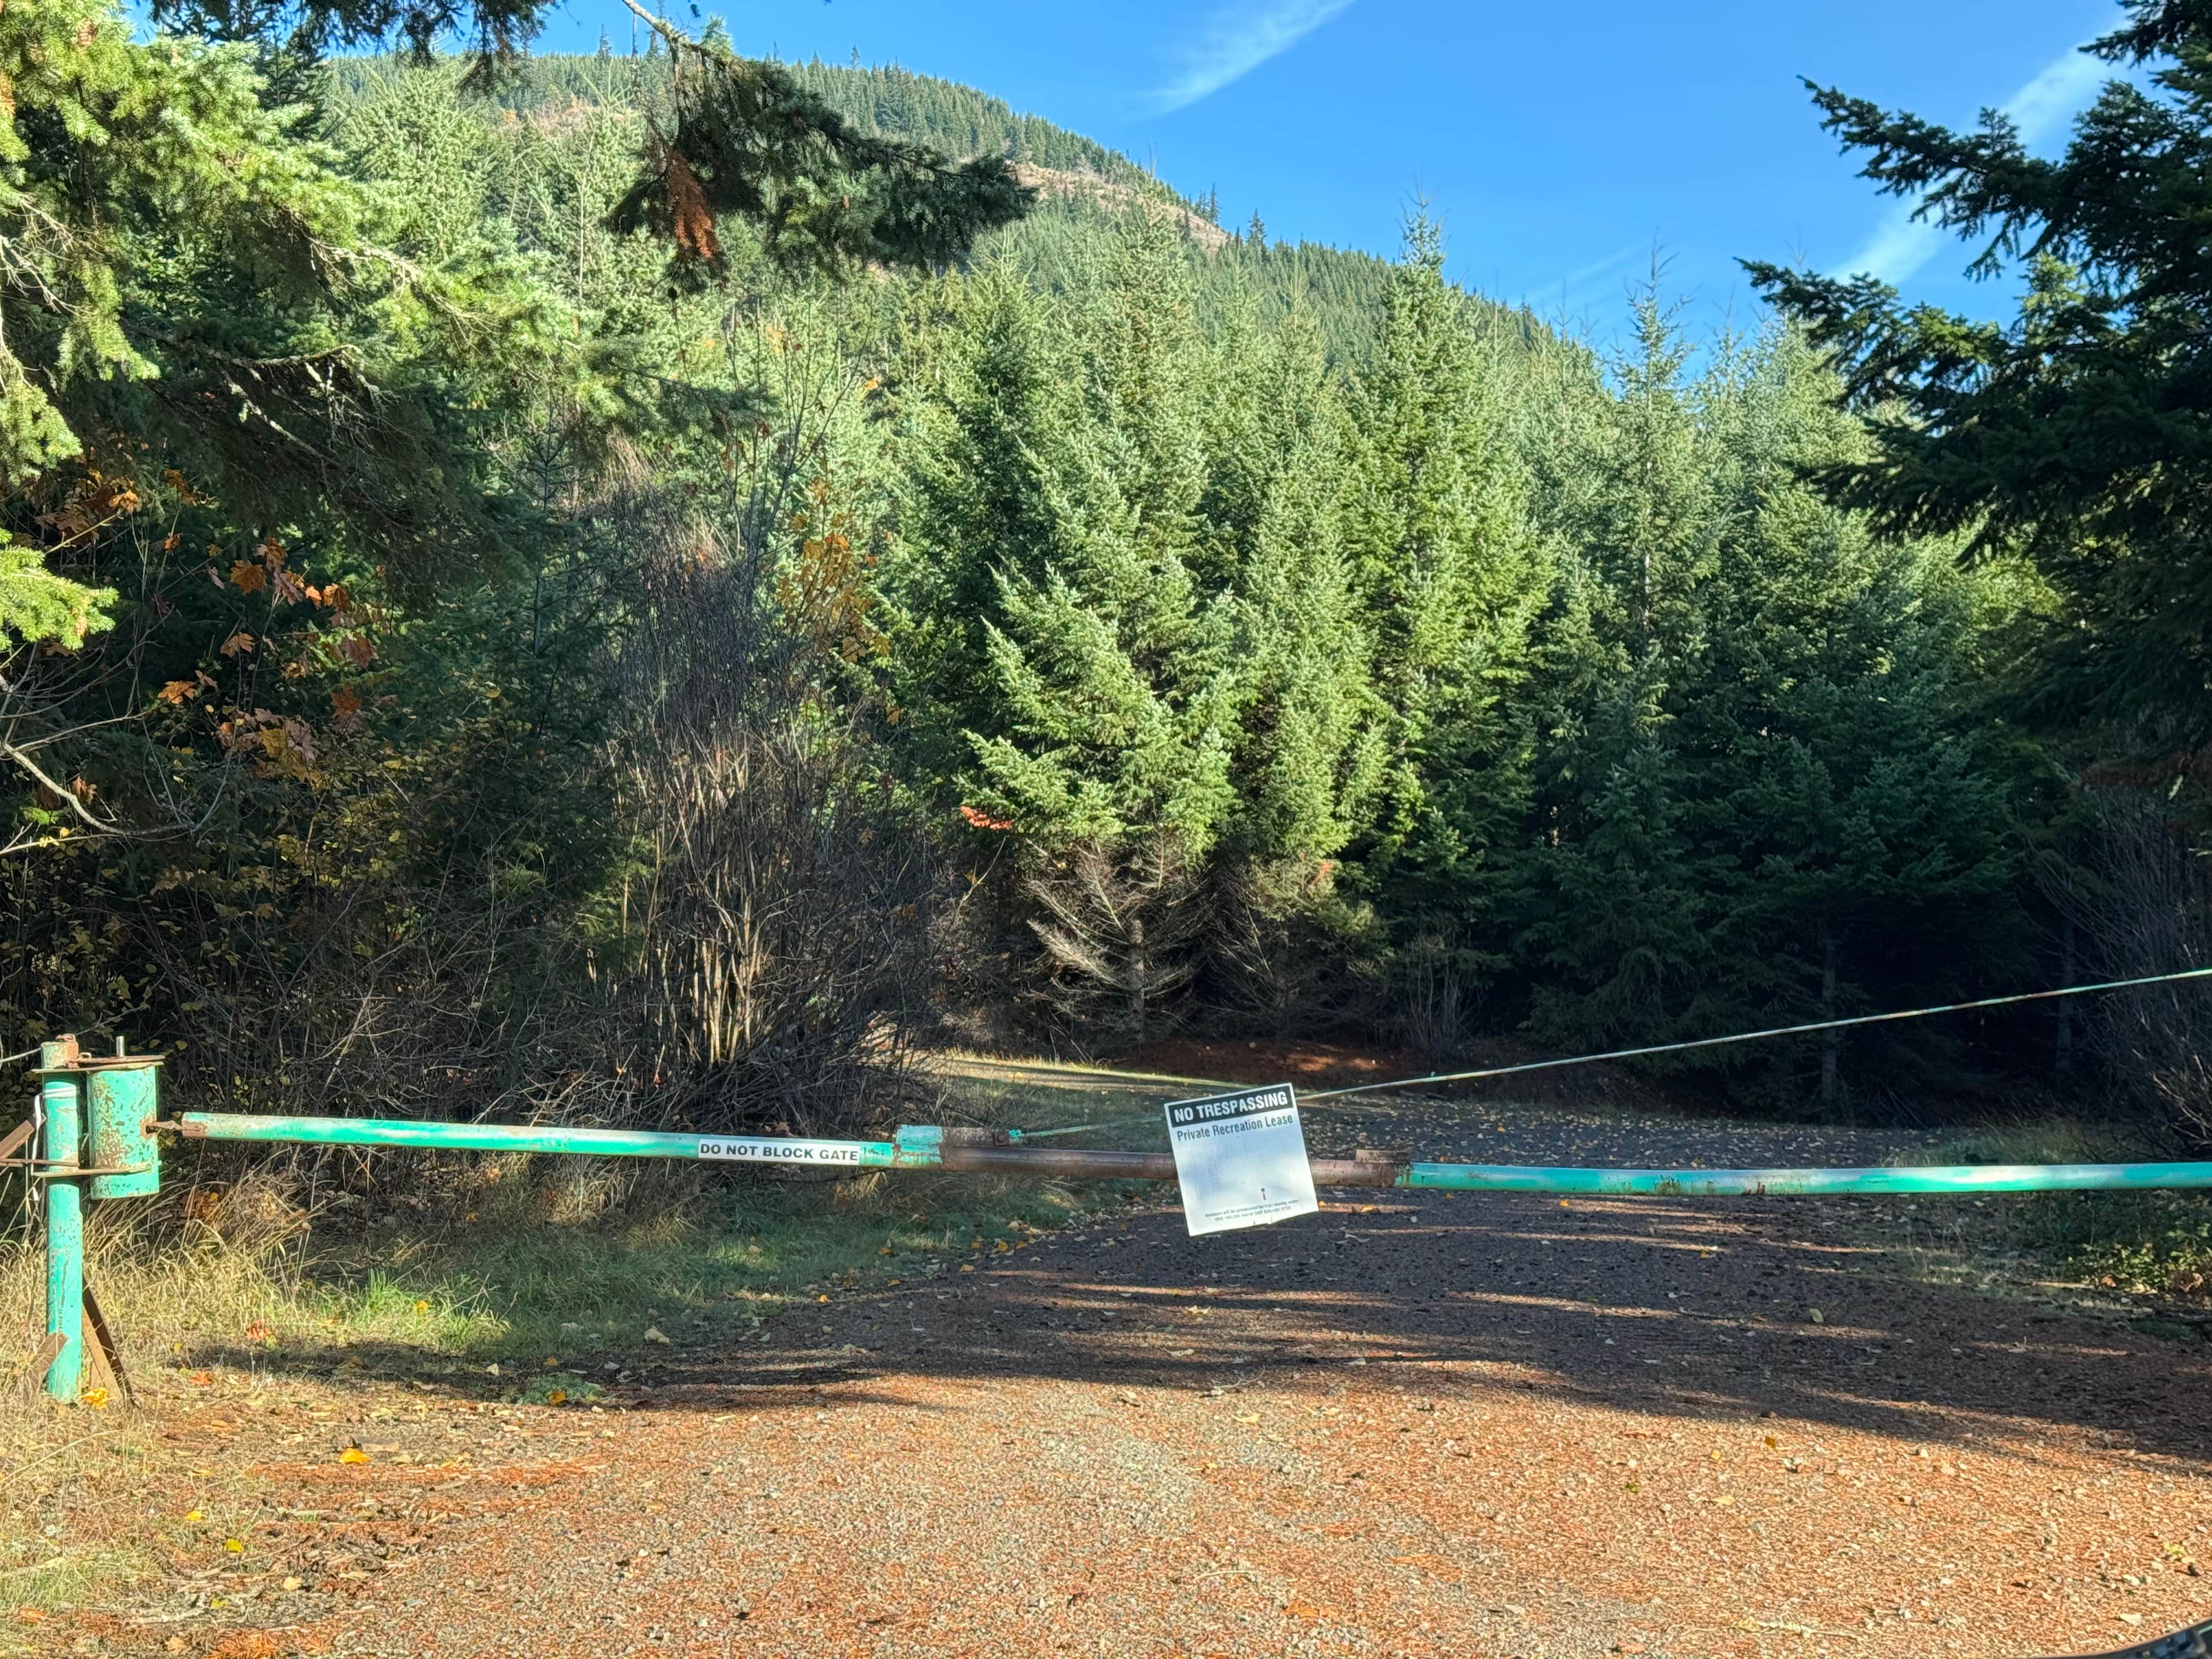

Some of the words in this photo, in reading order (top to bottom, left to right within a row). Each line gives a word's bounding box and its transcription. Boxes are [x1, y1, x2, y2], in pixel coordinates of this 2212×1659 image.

[1174, 1108, 1194, 1122] NO
[1195, 1091, 1288, 1119] TRESPASSING
[1177, 1128, 1210, 1142] Private
[1213, 1120, 1263, 1136] Recreation
[1266, 1113, 1293, 1127] Lease
[701, 1143, 721, 1154] DO
[726, 1144, 759, 1156] NOT
[763, 1147, 814, 1159] BLOCK
[819, 1149, 858, 1161] GATE
